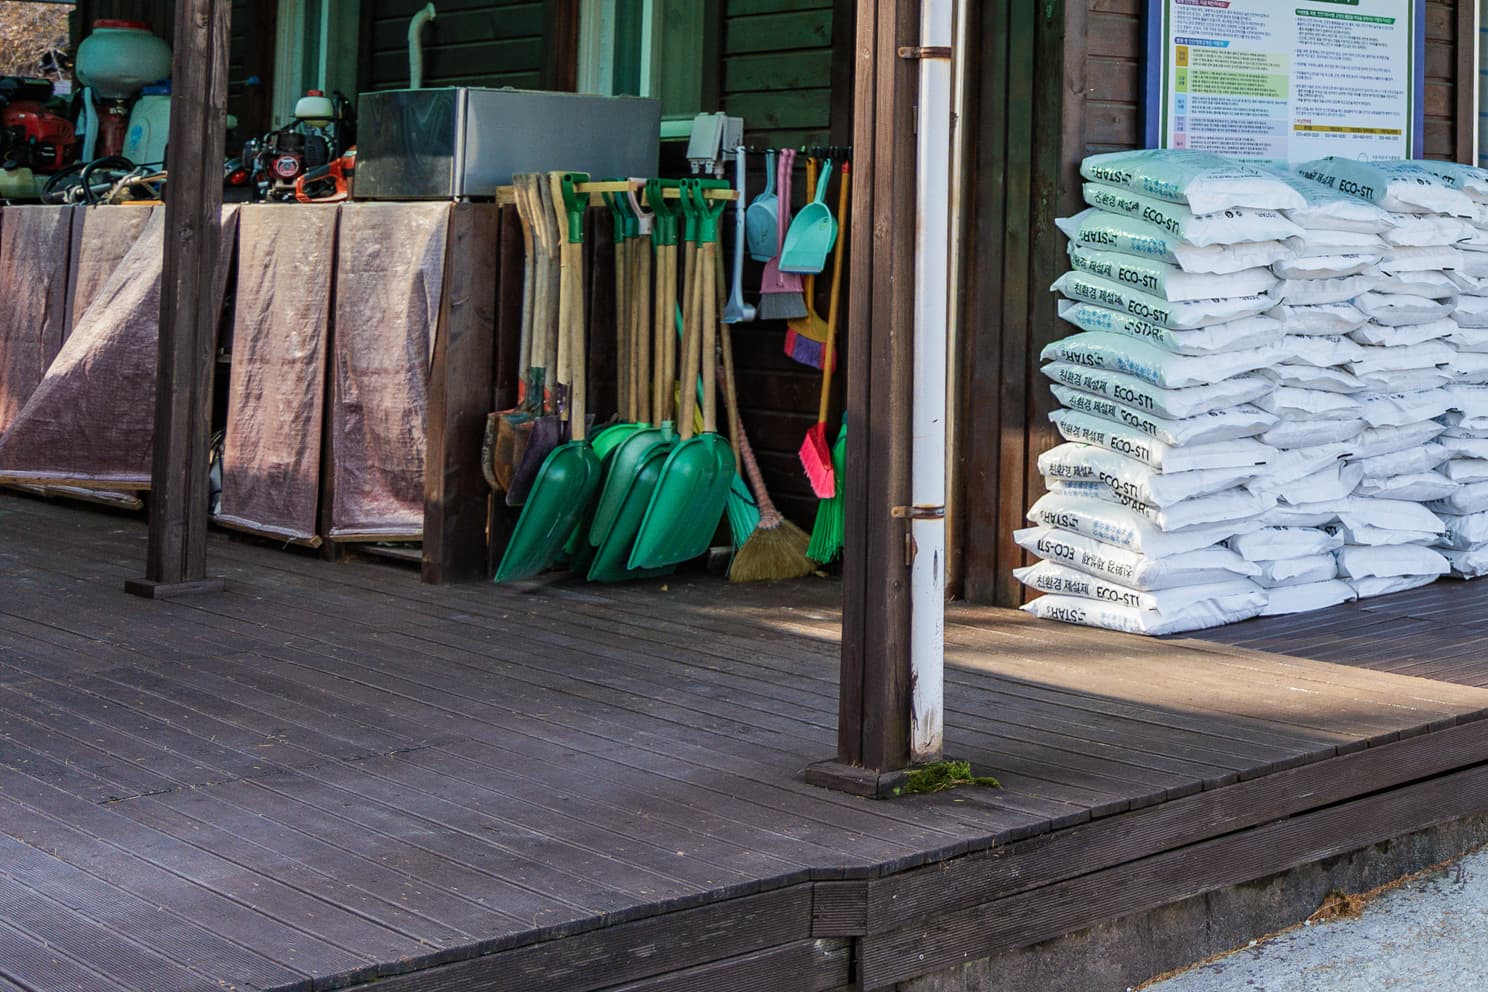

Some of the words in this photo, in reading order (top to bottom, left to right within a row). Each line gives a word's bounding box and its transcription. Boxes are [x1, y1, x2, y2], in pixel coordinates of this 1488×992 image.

[1075, 282, 1097, 299] 친환경
[1059, 369, 1082, 386] 친환경
[1083, 376, 1108, 393] 제설제
[1093, 401, 1117, 417] 제설제
[1060, 421, 1081, 439] 친환경
[1108, 560, 1133, 577] 친환경
[1036, 575, 1062, 590] 친환경
[1063, 579, 1090, 597] 제설제
